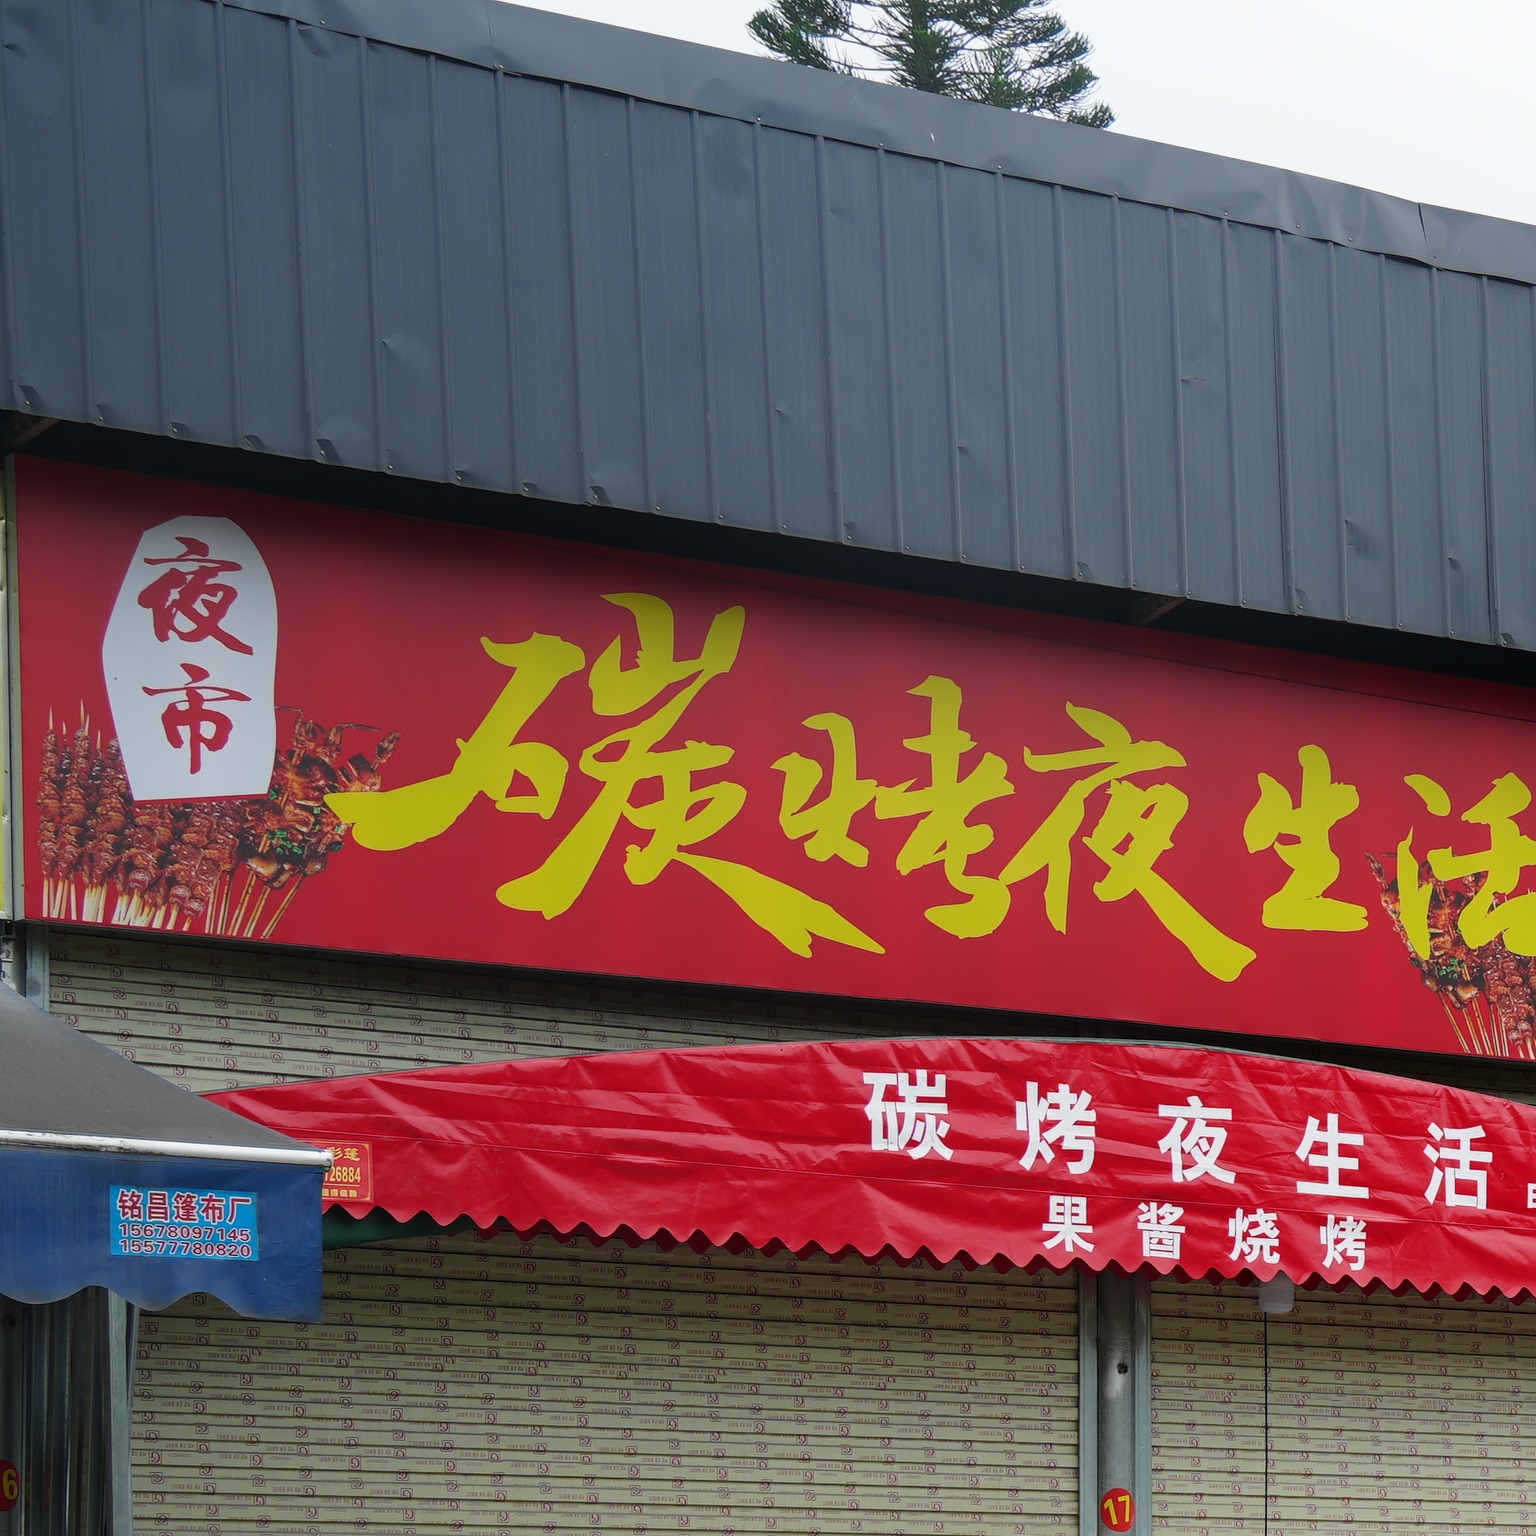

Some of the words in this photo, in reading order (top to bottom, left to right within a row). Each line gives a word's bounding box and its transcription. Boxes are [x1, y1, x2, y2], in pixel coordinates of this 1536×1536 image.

[137, 536, 254, 776] 夜市
[863, 1068, 1496, 1211] 碳烤夜生活
[117, 1188, 252, 1225] 铭昌篷布厂
[118, 1223, 251, 1242] 15678097145
[118, 1239, 252, 1258] 15577780820
[1041, 1195, 1368, 1271] 果酱烧烤
[1103, 1494, 1131, 1526] 17
